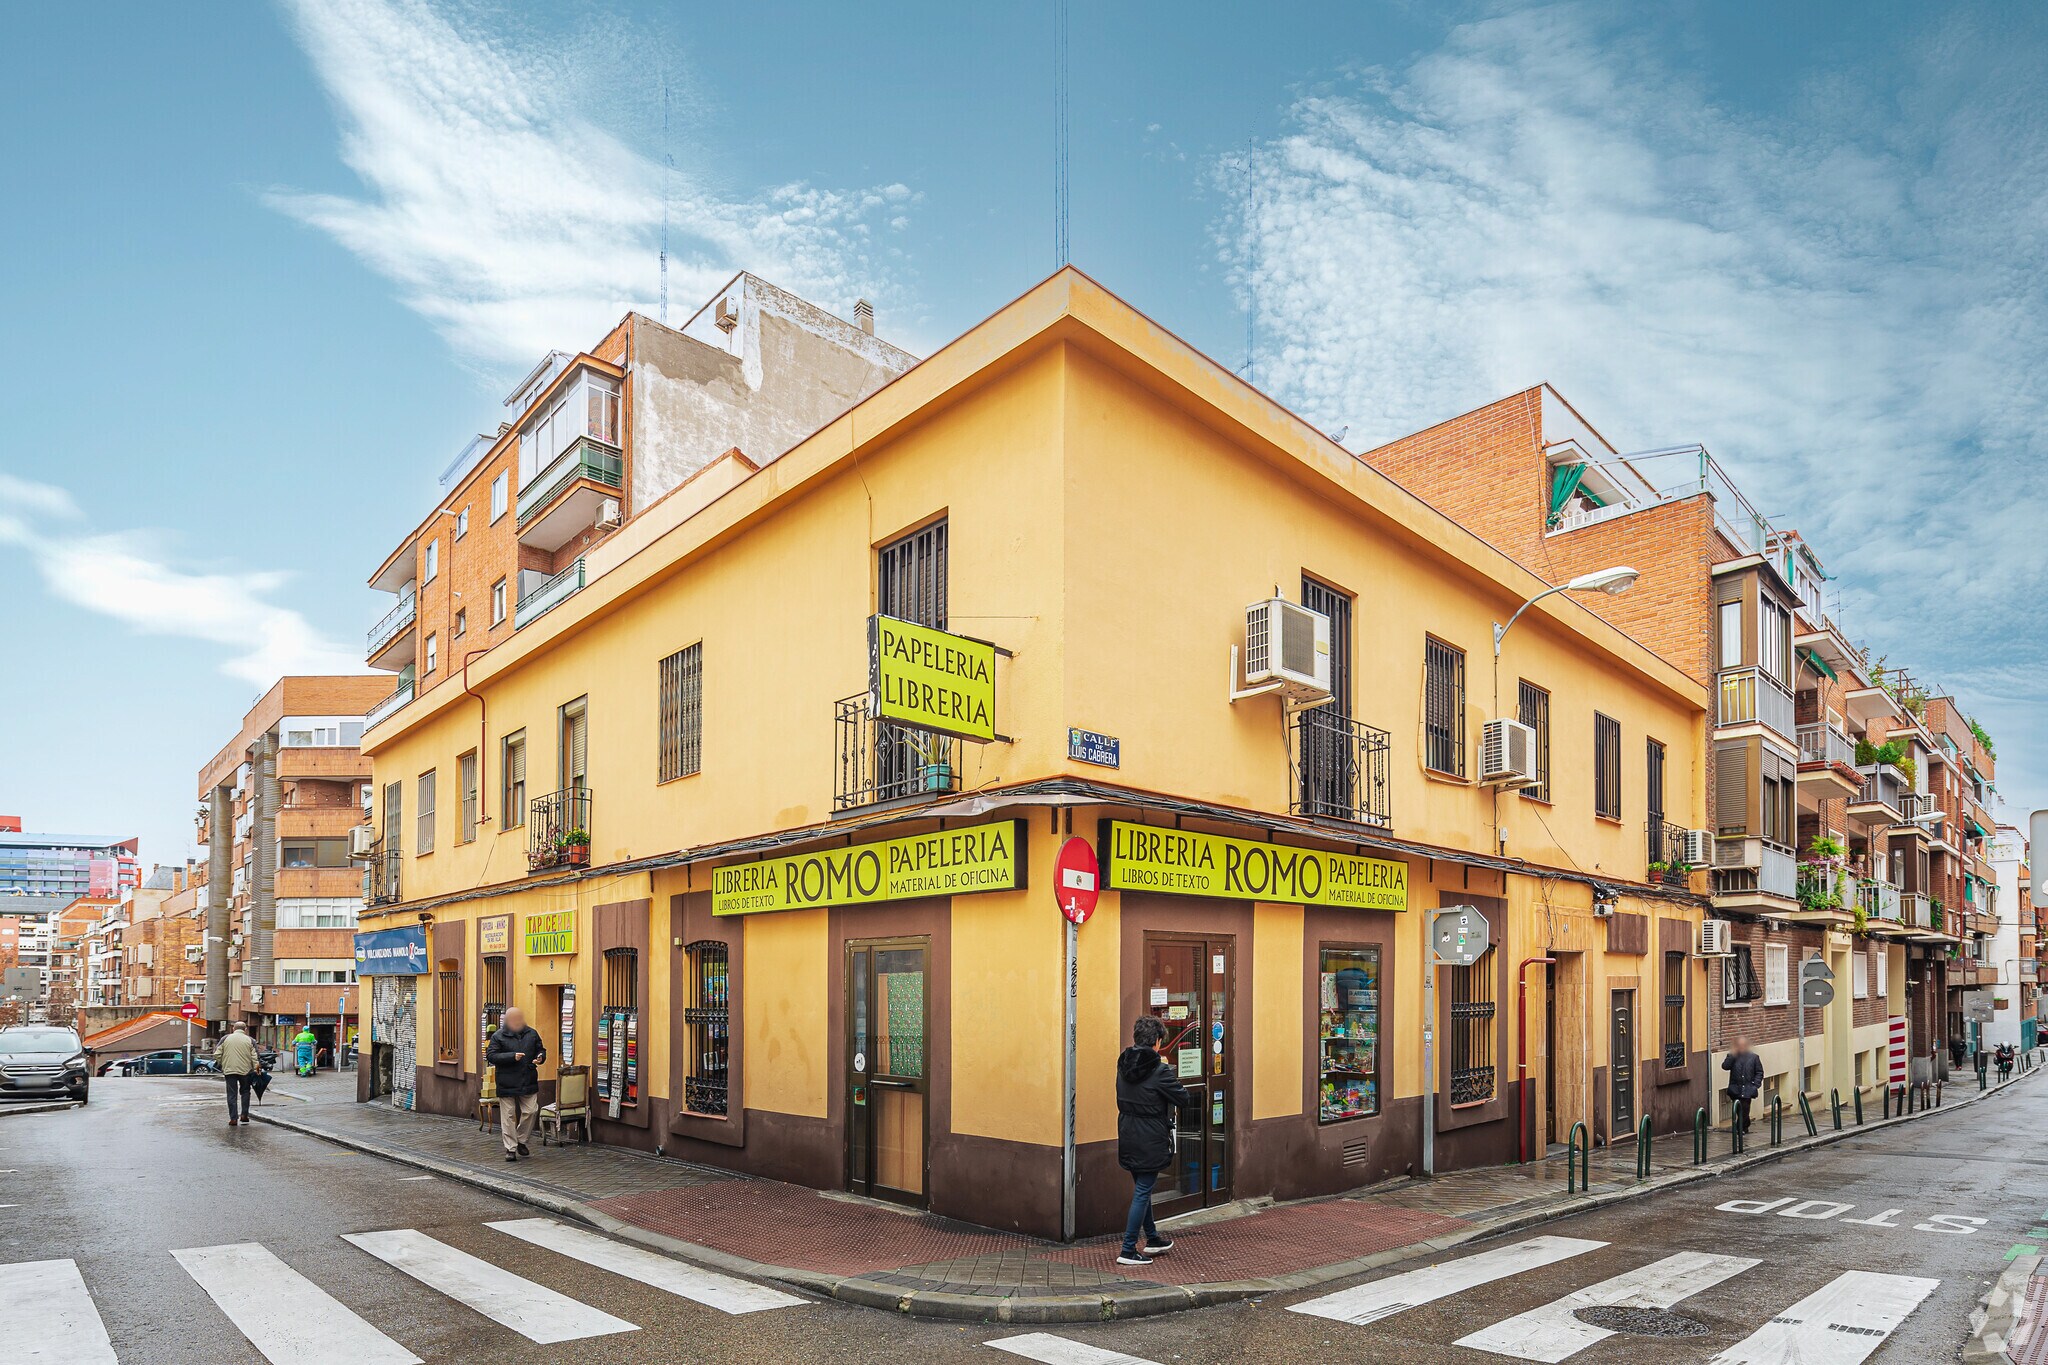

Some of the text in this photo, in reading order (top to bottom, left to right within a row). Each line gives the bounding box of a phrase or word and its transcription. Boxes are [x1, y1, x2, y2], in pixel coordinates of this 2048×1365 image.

[883, 629, 990, 685] PAPELERIA
[884, 673, 990, 728] LIBRERIA
[1071, 745, 1117, 766] LUIS CABRERA
[1083, 733, 1116, 748] CALLE
[889, 829, 1009, 874] PAPELERIA
[1115, 827, 1215, 869] LIBRERIA
[715, 865, 779, 895] LIBRERIA
[784, 849, 882, 905] ROMO
[890, 867, 1009, 894] MATERIAL DE OFICINA
[1122, 867, 1210, 890] LIBROS DE TEXTO
[1224, 843, 1323, 899] ROMO
[1329, 857, 1405, 891] PAPELERIA
[718, 894, 775, 911] LIBROS DE TEXTO
[1328, 888, 1405, 907] MATERIAL DE OFICINA
[532, 932, 566, 954] MINIÑO
[1714, 1197, 1990, 1235] STOP
